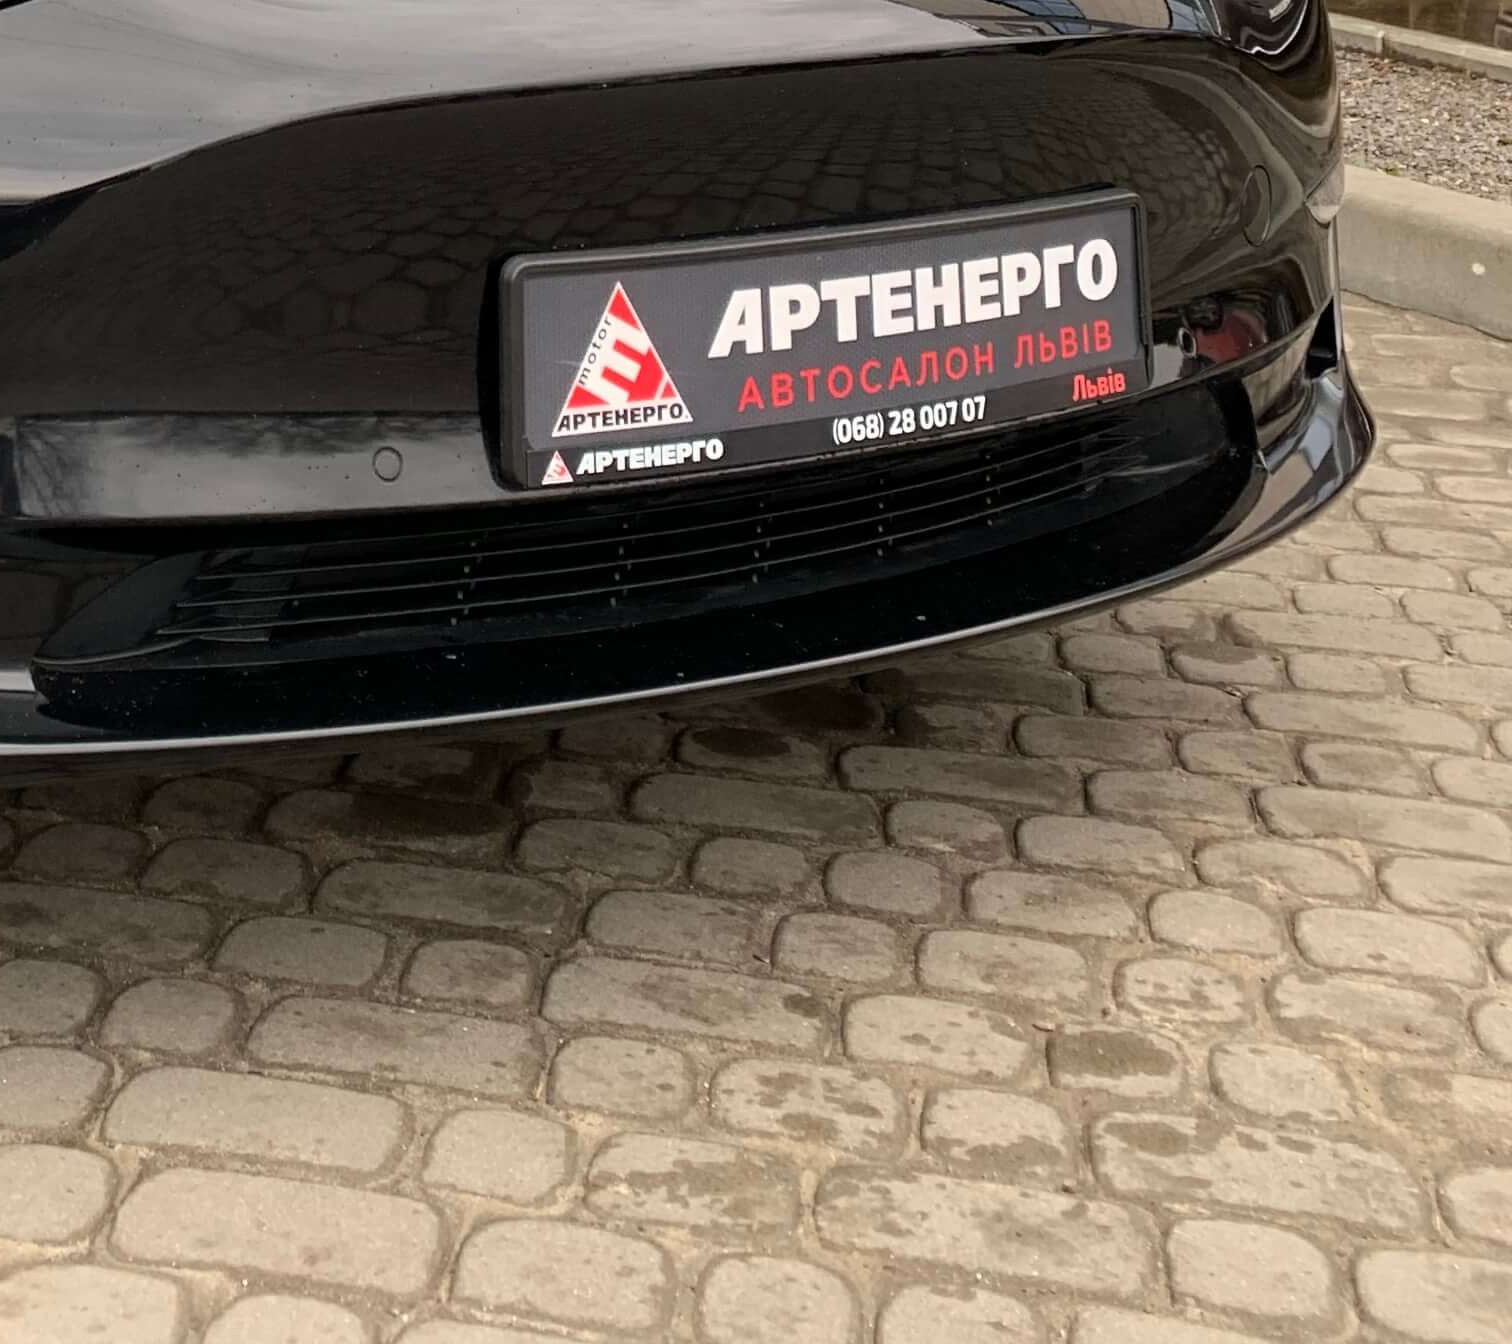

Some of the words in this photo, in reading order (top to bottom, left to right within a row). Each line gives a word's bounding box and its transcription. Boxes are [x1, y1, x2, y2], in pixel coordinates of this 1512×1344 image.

[707, 238, 1119, 359] АРТЕНЕРГО
[578, 317, 612, 385] motor
[737, 341, 995, 413] АВТОСАЛОН
[1013, 319, 1113, 368] ЛЬВІВ
[1071, 368, 1127, 403] Львів
[557, 402, 684, 433] АРТЕНЕРГО
[832, 412, 885, 446] (068)
[888, 408, 916, 436] 28
[919, 400, 959, 431] 007
[961, 394, 987, 423] 07
[576, 437, 725, 476] АРТЕНЕРГО
